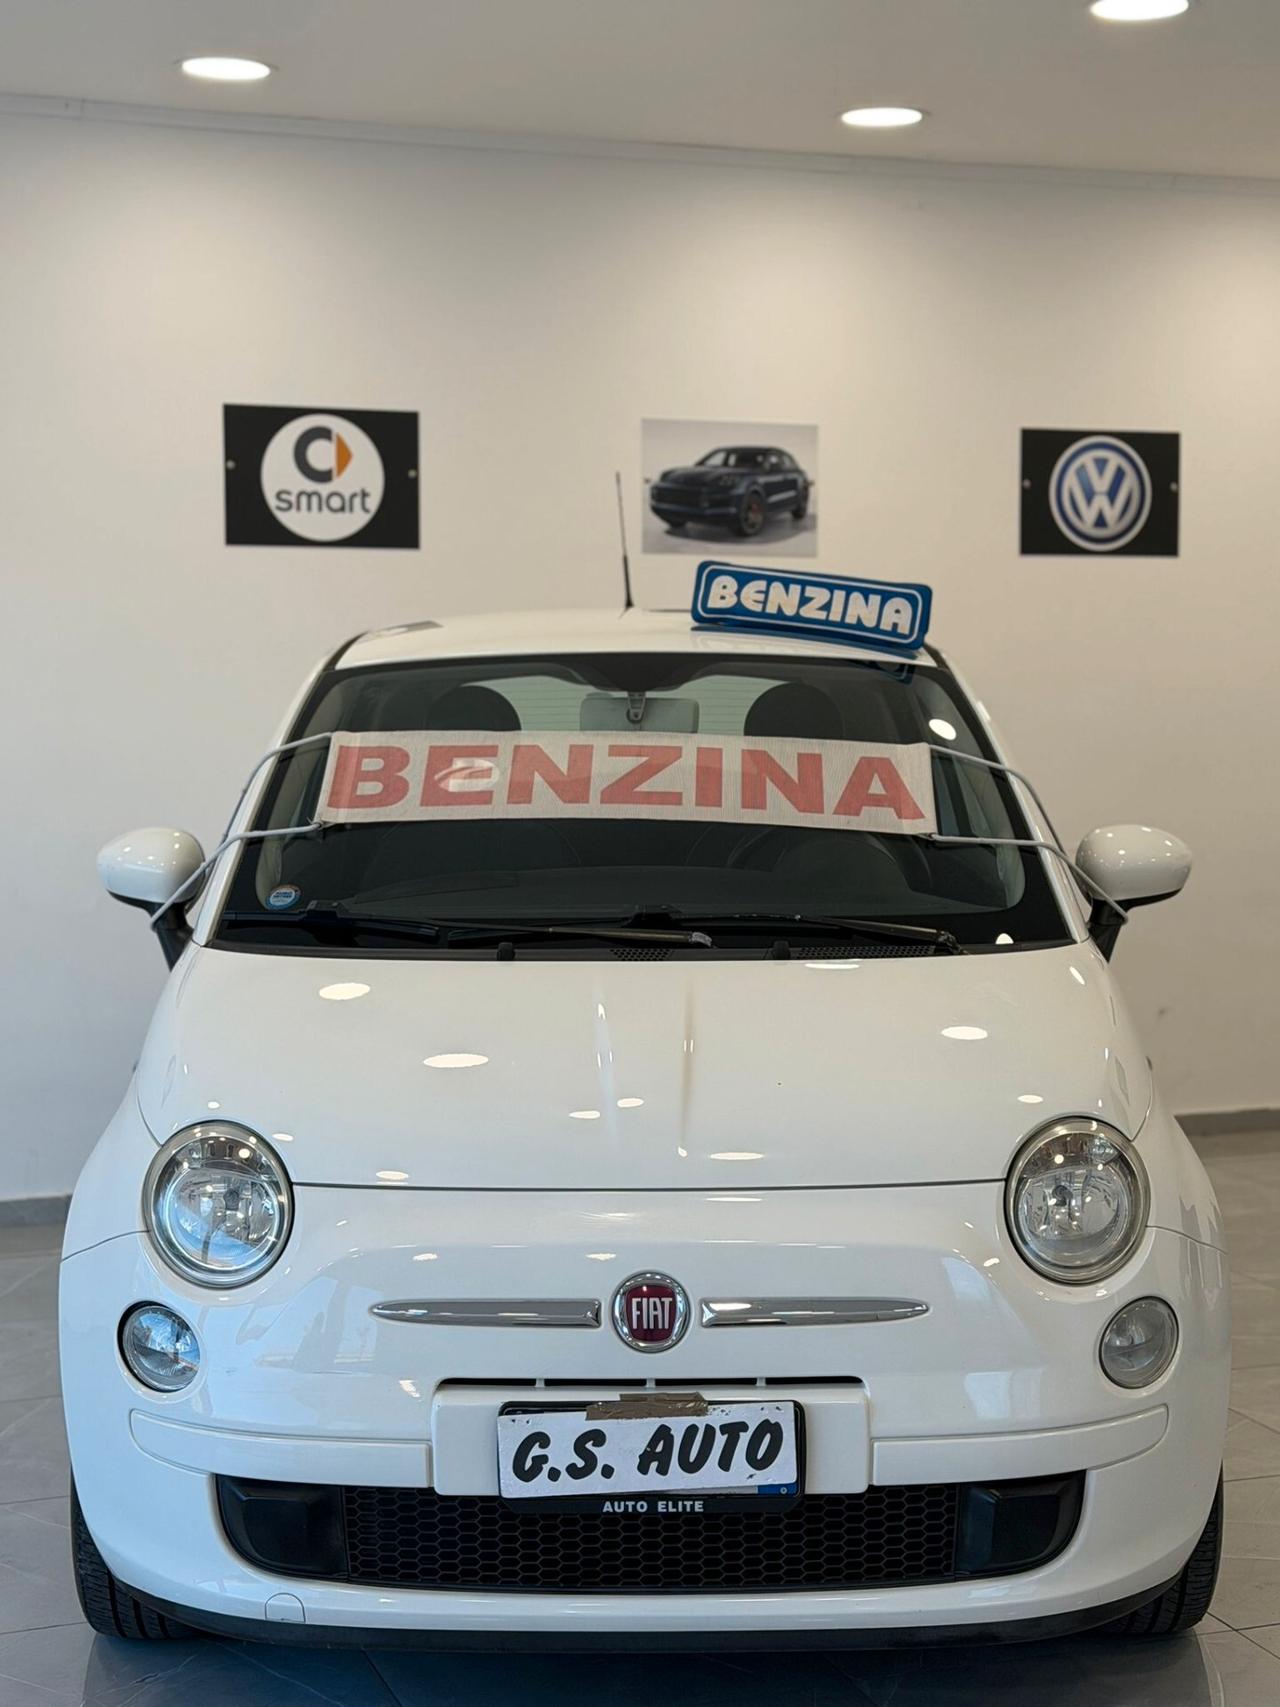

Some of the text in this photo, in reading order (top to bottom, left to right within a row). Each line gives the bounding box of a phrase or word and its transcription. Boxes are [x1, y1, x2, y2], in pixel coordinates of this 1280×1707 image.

[275, 488, 371, 514] smart
[707, 575, 913, 635] BENZINA
[325, 744, 925, 819] BENZINA
[631, 1297, 673, 1329] FIAT
[512, 1419, 784, 1483] G.S. AUTO
[602, 1501, 704, 1513] AUTO ELITE
